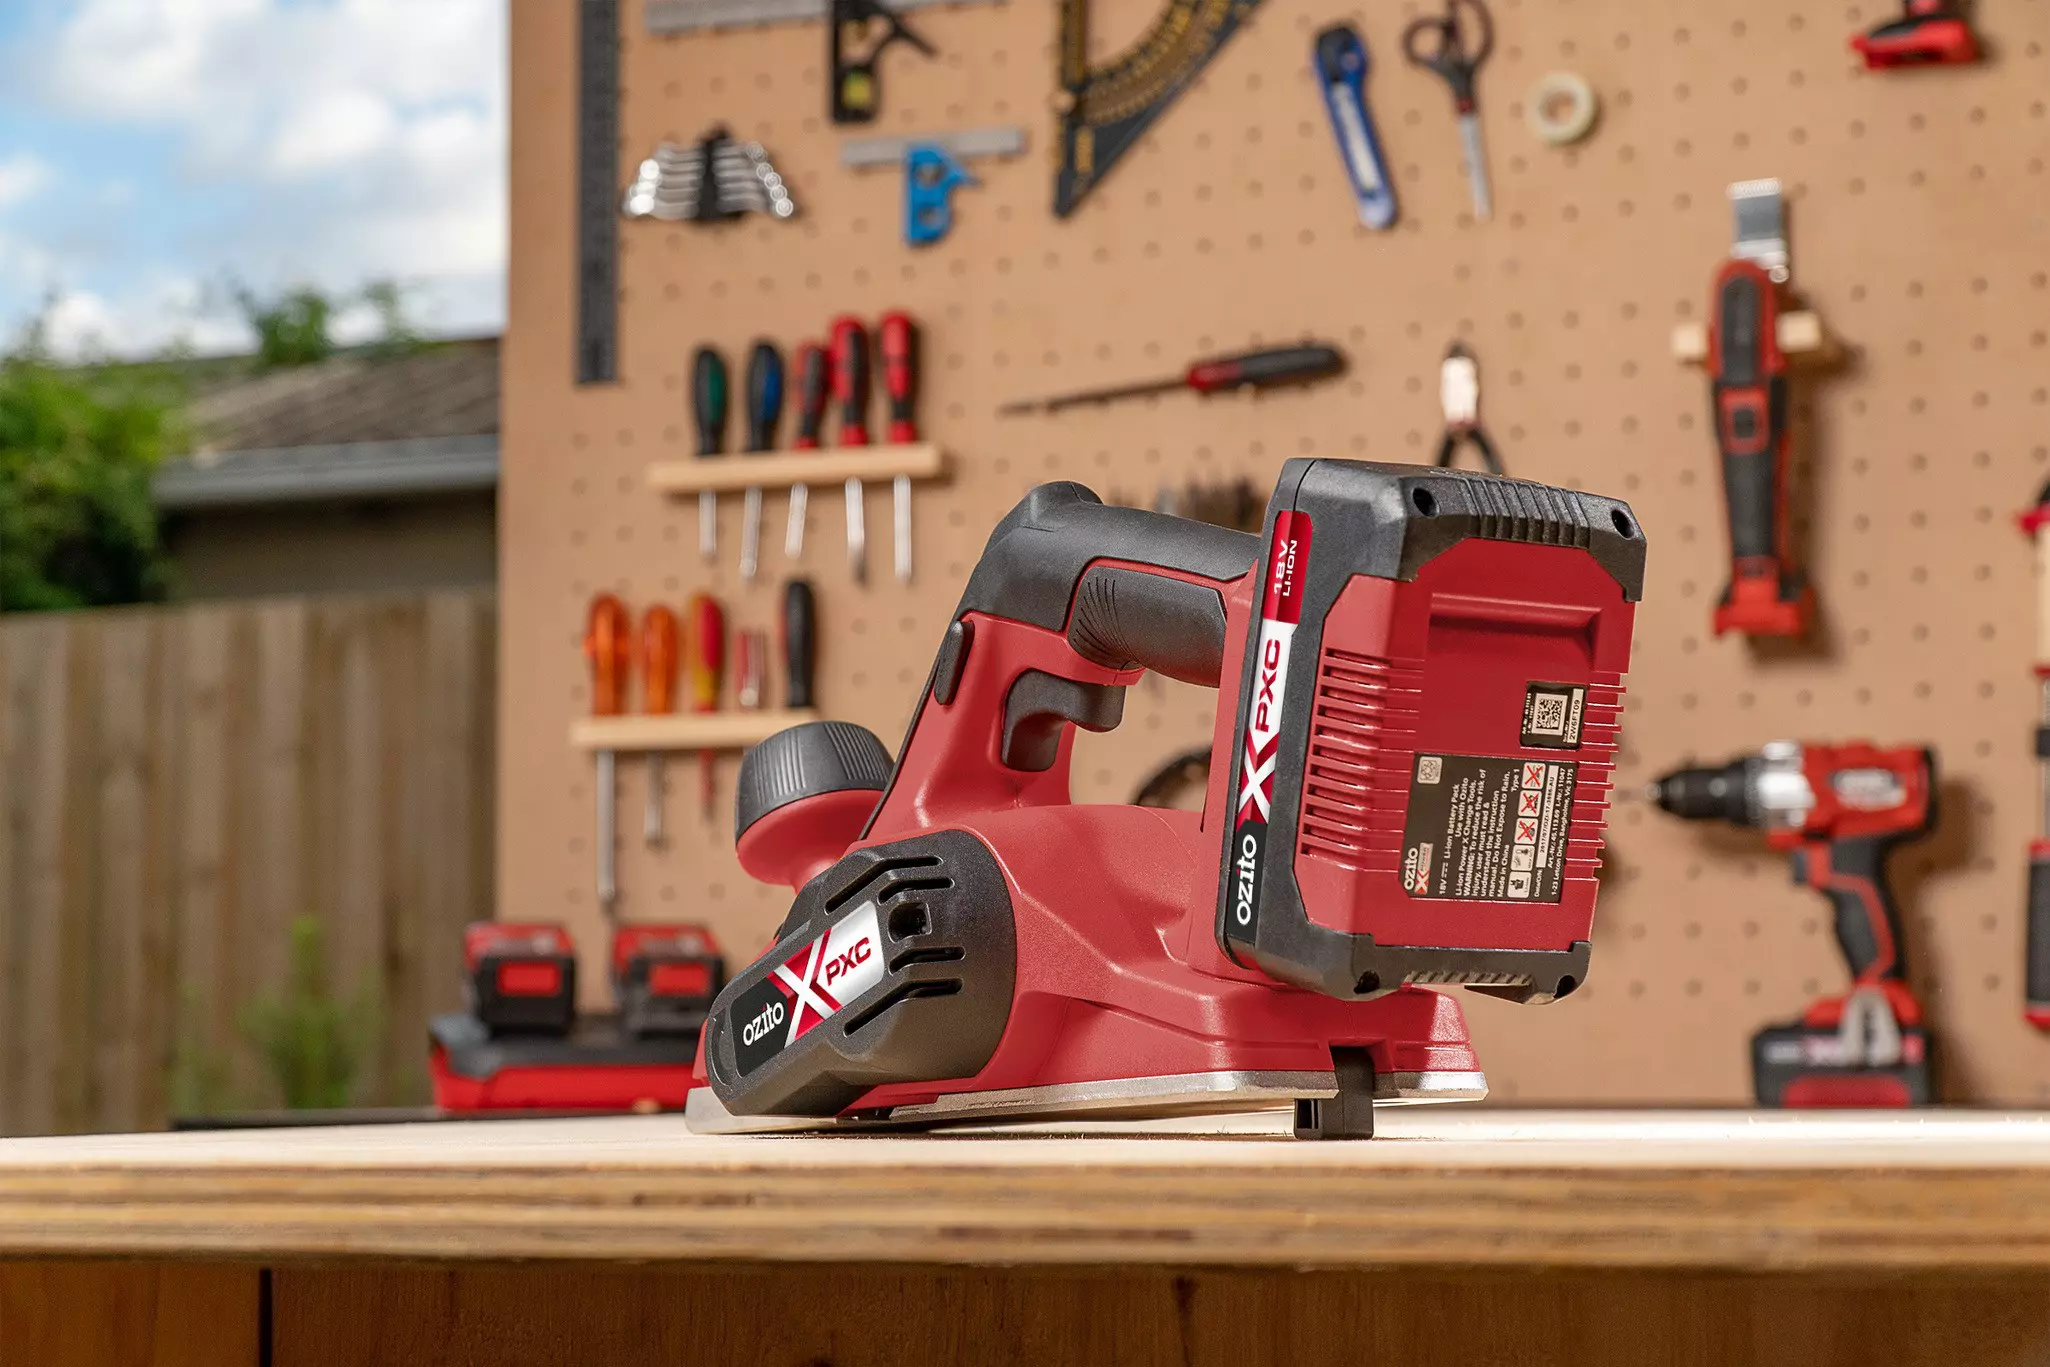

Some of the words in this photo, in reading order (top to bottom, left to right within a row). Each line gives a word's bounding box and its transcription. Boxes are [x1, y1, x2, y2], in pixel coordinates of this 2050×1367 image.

[1274, 540, 1288, 594] 18V
[1283, 540, 1298, 597] LI-ION
[1236, 834, 1257, 925] ozito
[1255, 639, 1281, 733] PXC
[1479, 769, 1486, 778] of
[1501, 772, 1510, 791] Rain.
[1511, 775, 1519, 792] Type
[1451, 784, 1460, 802] Pack
[1467, 780, 1476, 803] Tools.
[1477, 780, 1485, 794] risk
[1500, 793, 1507, 802] to
[1447, 804, 1459, 834] Battery
[1455, 822, 1463, 837] Use
[1460, 778, 1468, 800] Ozito
[1463, 805, 1474, 836] Change
[1488, 791, 1499, 833] instruction
[1496, 804, 1506, 832] Expose
[1472, 812, 1480, 839] reduce
[1444, 836, 1453, 858] Li-ion
[1469, 841, 1476, 851] To
[1486, 835, 1494, 849] the
[1494, 834, 1502, 849] Not
[1404, 848, 1418, 890] ozito
[1458, 846, 1468, 871] Power
[1492, 851, 1499, 862] Do
[1463, 853, 1475, 896] WARNING:
[1481, 851, 1491, 896] understand
[1489, 865, 1498, 897] manual.
[1497, 876, 1505, 897] Made
[1501, 845, 1509, 866] China
[1439, 879, 1447, 894] 18V
[1455, 873, 1464, 896] Li-ion
[742, 1002, 784, 1046] ozito
[825, 937, 872, 986] PXC
